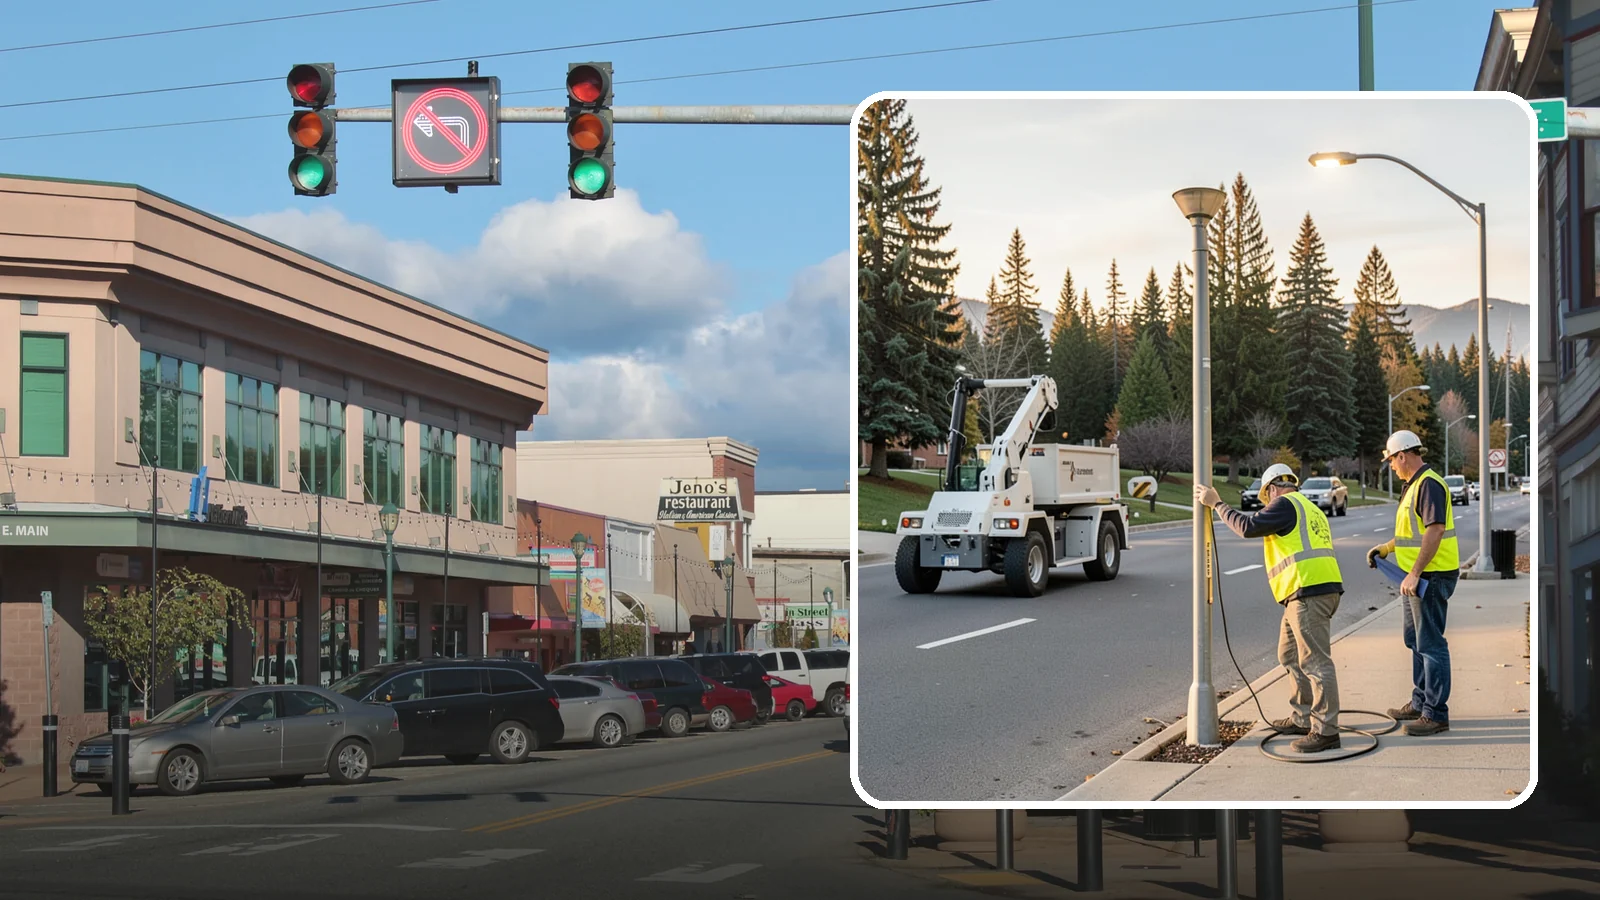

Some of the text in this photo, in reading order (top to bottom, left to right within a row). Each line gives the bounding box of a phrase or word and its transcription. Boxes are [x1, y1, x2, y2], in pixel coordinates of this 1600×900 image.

[669, 480, 728, 495] Jeno's
[665, 497, 731, 509] restaurant
[658, 510, 682, 520] Italian
[686, 509, 714, 520] American
[715, 509, 738, 519] Cuisine
[2, 525, 49, 536] E. MAIN
[797, 607, 828, 617] Street
[791, 619, 824, 627] lass
